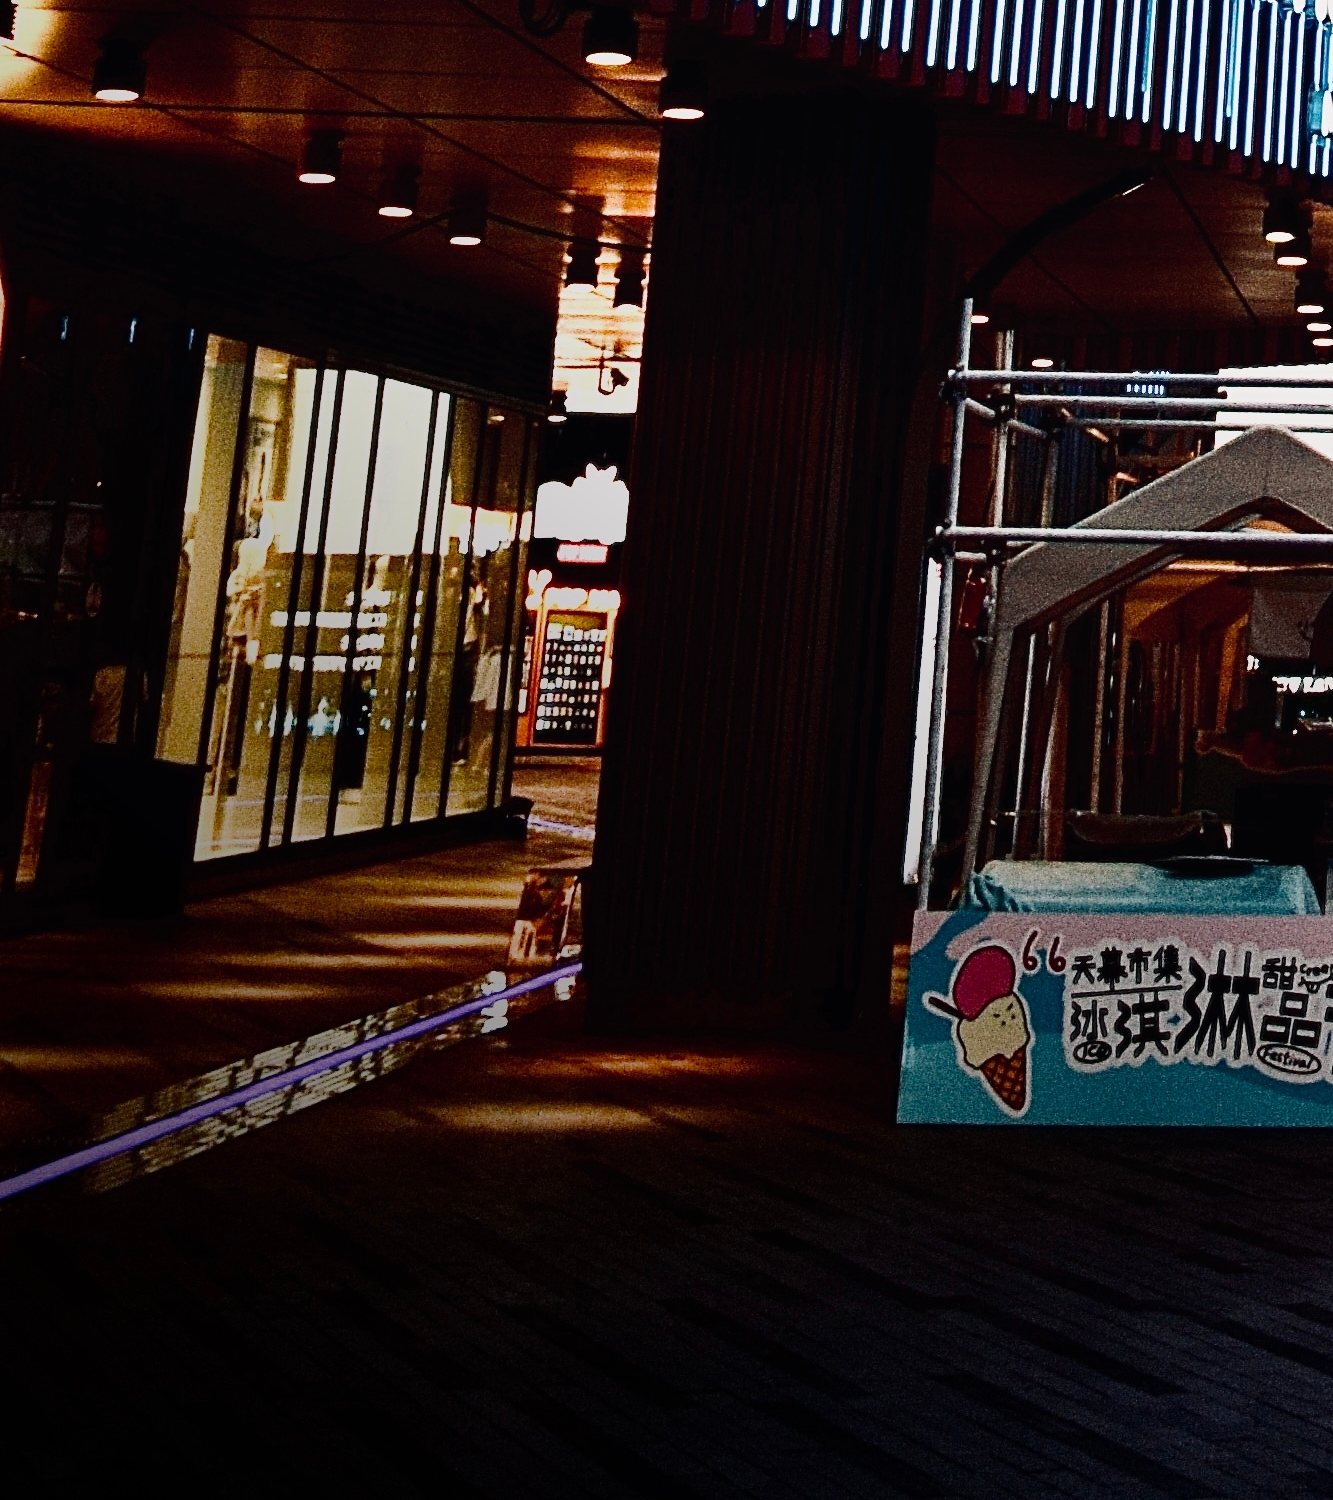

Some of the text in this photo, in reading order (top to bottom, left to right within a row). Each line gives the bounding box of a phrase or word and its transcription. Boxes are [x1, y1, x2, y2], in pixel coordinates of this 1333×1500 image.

[1071, 943, 1183, 988] 天幕市集
[1262, 1049, 1315, 1070] Festival
